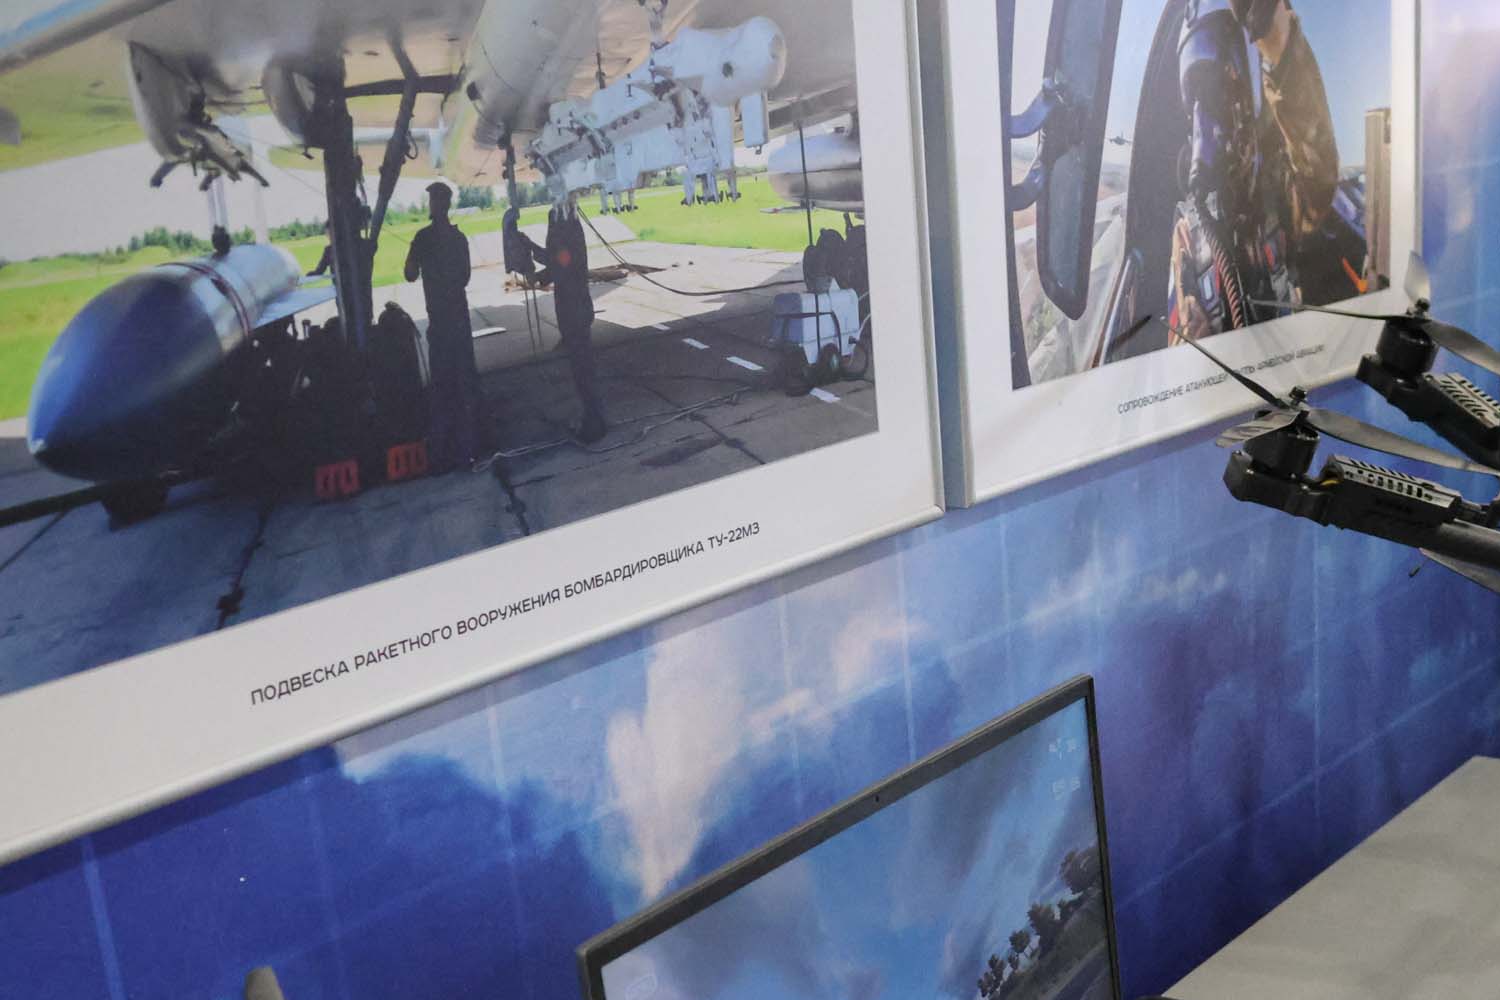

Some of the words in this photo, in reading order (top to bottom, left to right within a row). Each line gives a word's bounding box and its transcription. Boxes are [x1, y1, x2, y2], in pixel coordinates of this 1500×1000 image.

[250, 660, 350, 705] ПОДВЕСКА
[354, 625, 453, 670] РАКЕТНОГО
[456, 588, 560, 636] ВООРУЖЕНИЯ
[564, 540, 705, 599] БОМБАРДИРОВЩИКА
[707, 521, 761, 550] ТУ-22М3
